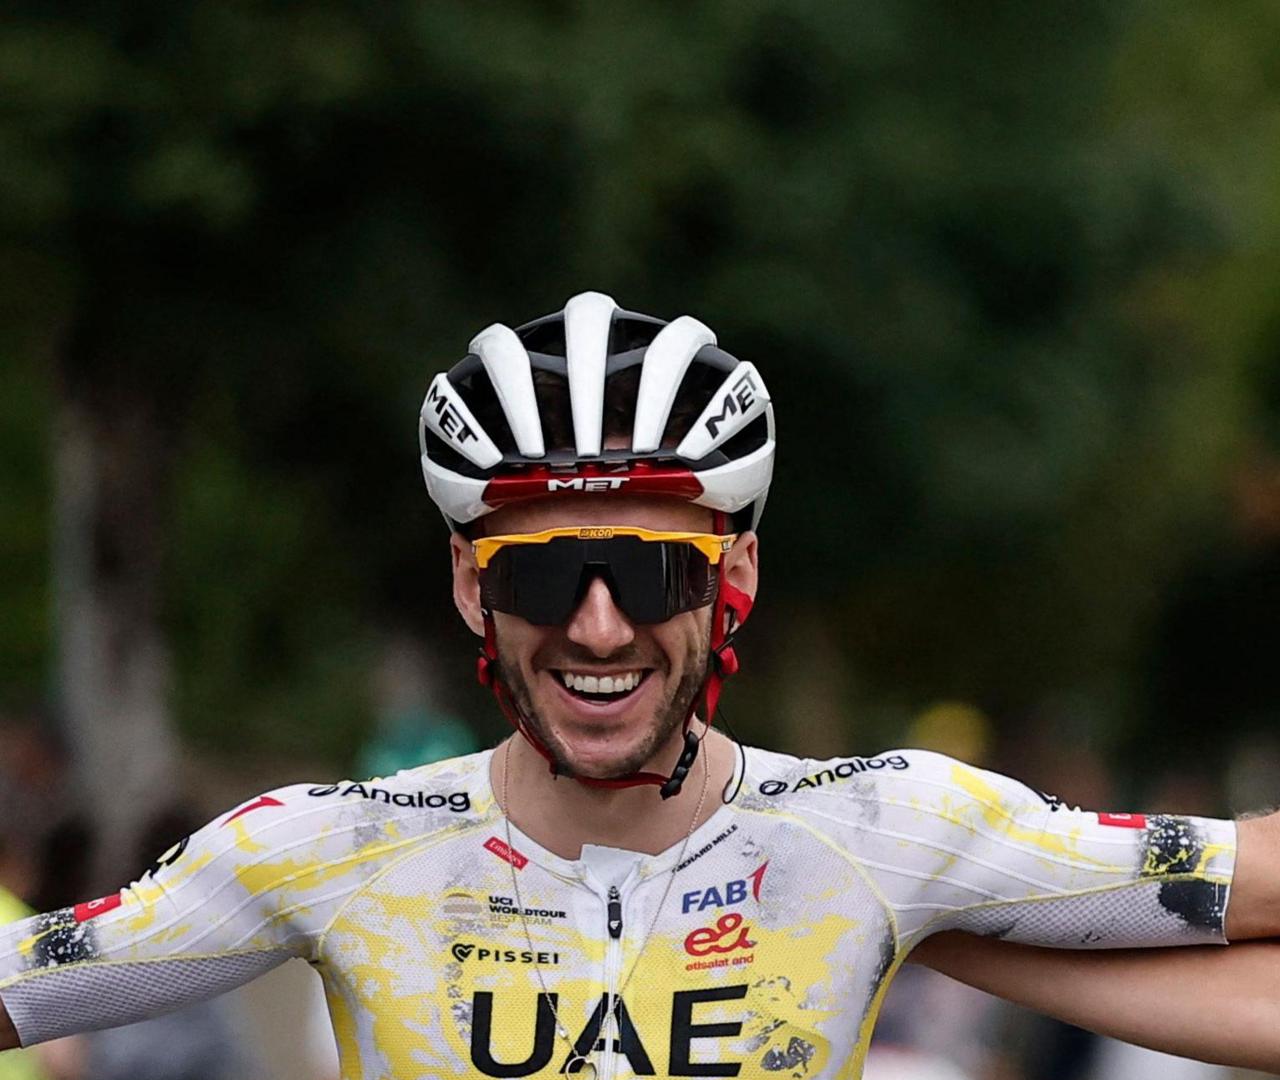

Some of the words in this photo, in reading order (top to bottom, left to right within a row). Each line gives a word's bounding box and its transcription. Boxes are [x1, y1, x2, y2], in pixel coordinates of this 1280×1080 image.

[427, 384, 480, 446] MET
[704, 370, 757, 440] MET
[547, 476, 631, 493] MET
[791, 754, 910, 793] Analog
[340, 783, 472, 812] Analog
[711, 823, 738, 848] MILLE
[488, 895, 513, 906] UCI
[681, 878, 749, 915] FAB
[489, 904, 567, 919] WORDTOUR
[478, 948, 560, 965] PISSEI
[685, 957, 731, 972] etisalat
[732, 953, 755, 967] and
[470, 983, 750, 1079] UAE
